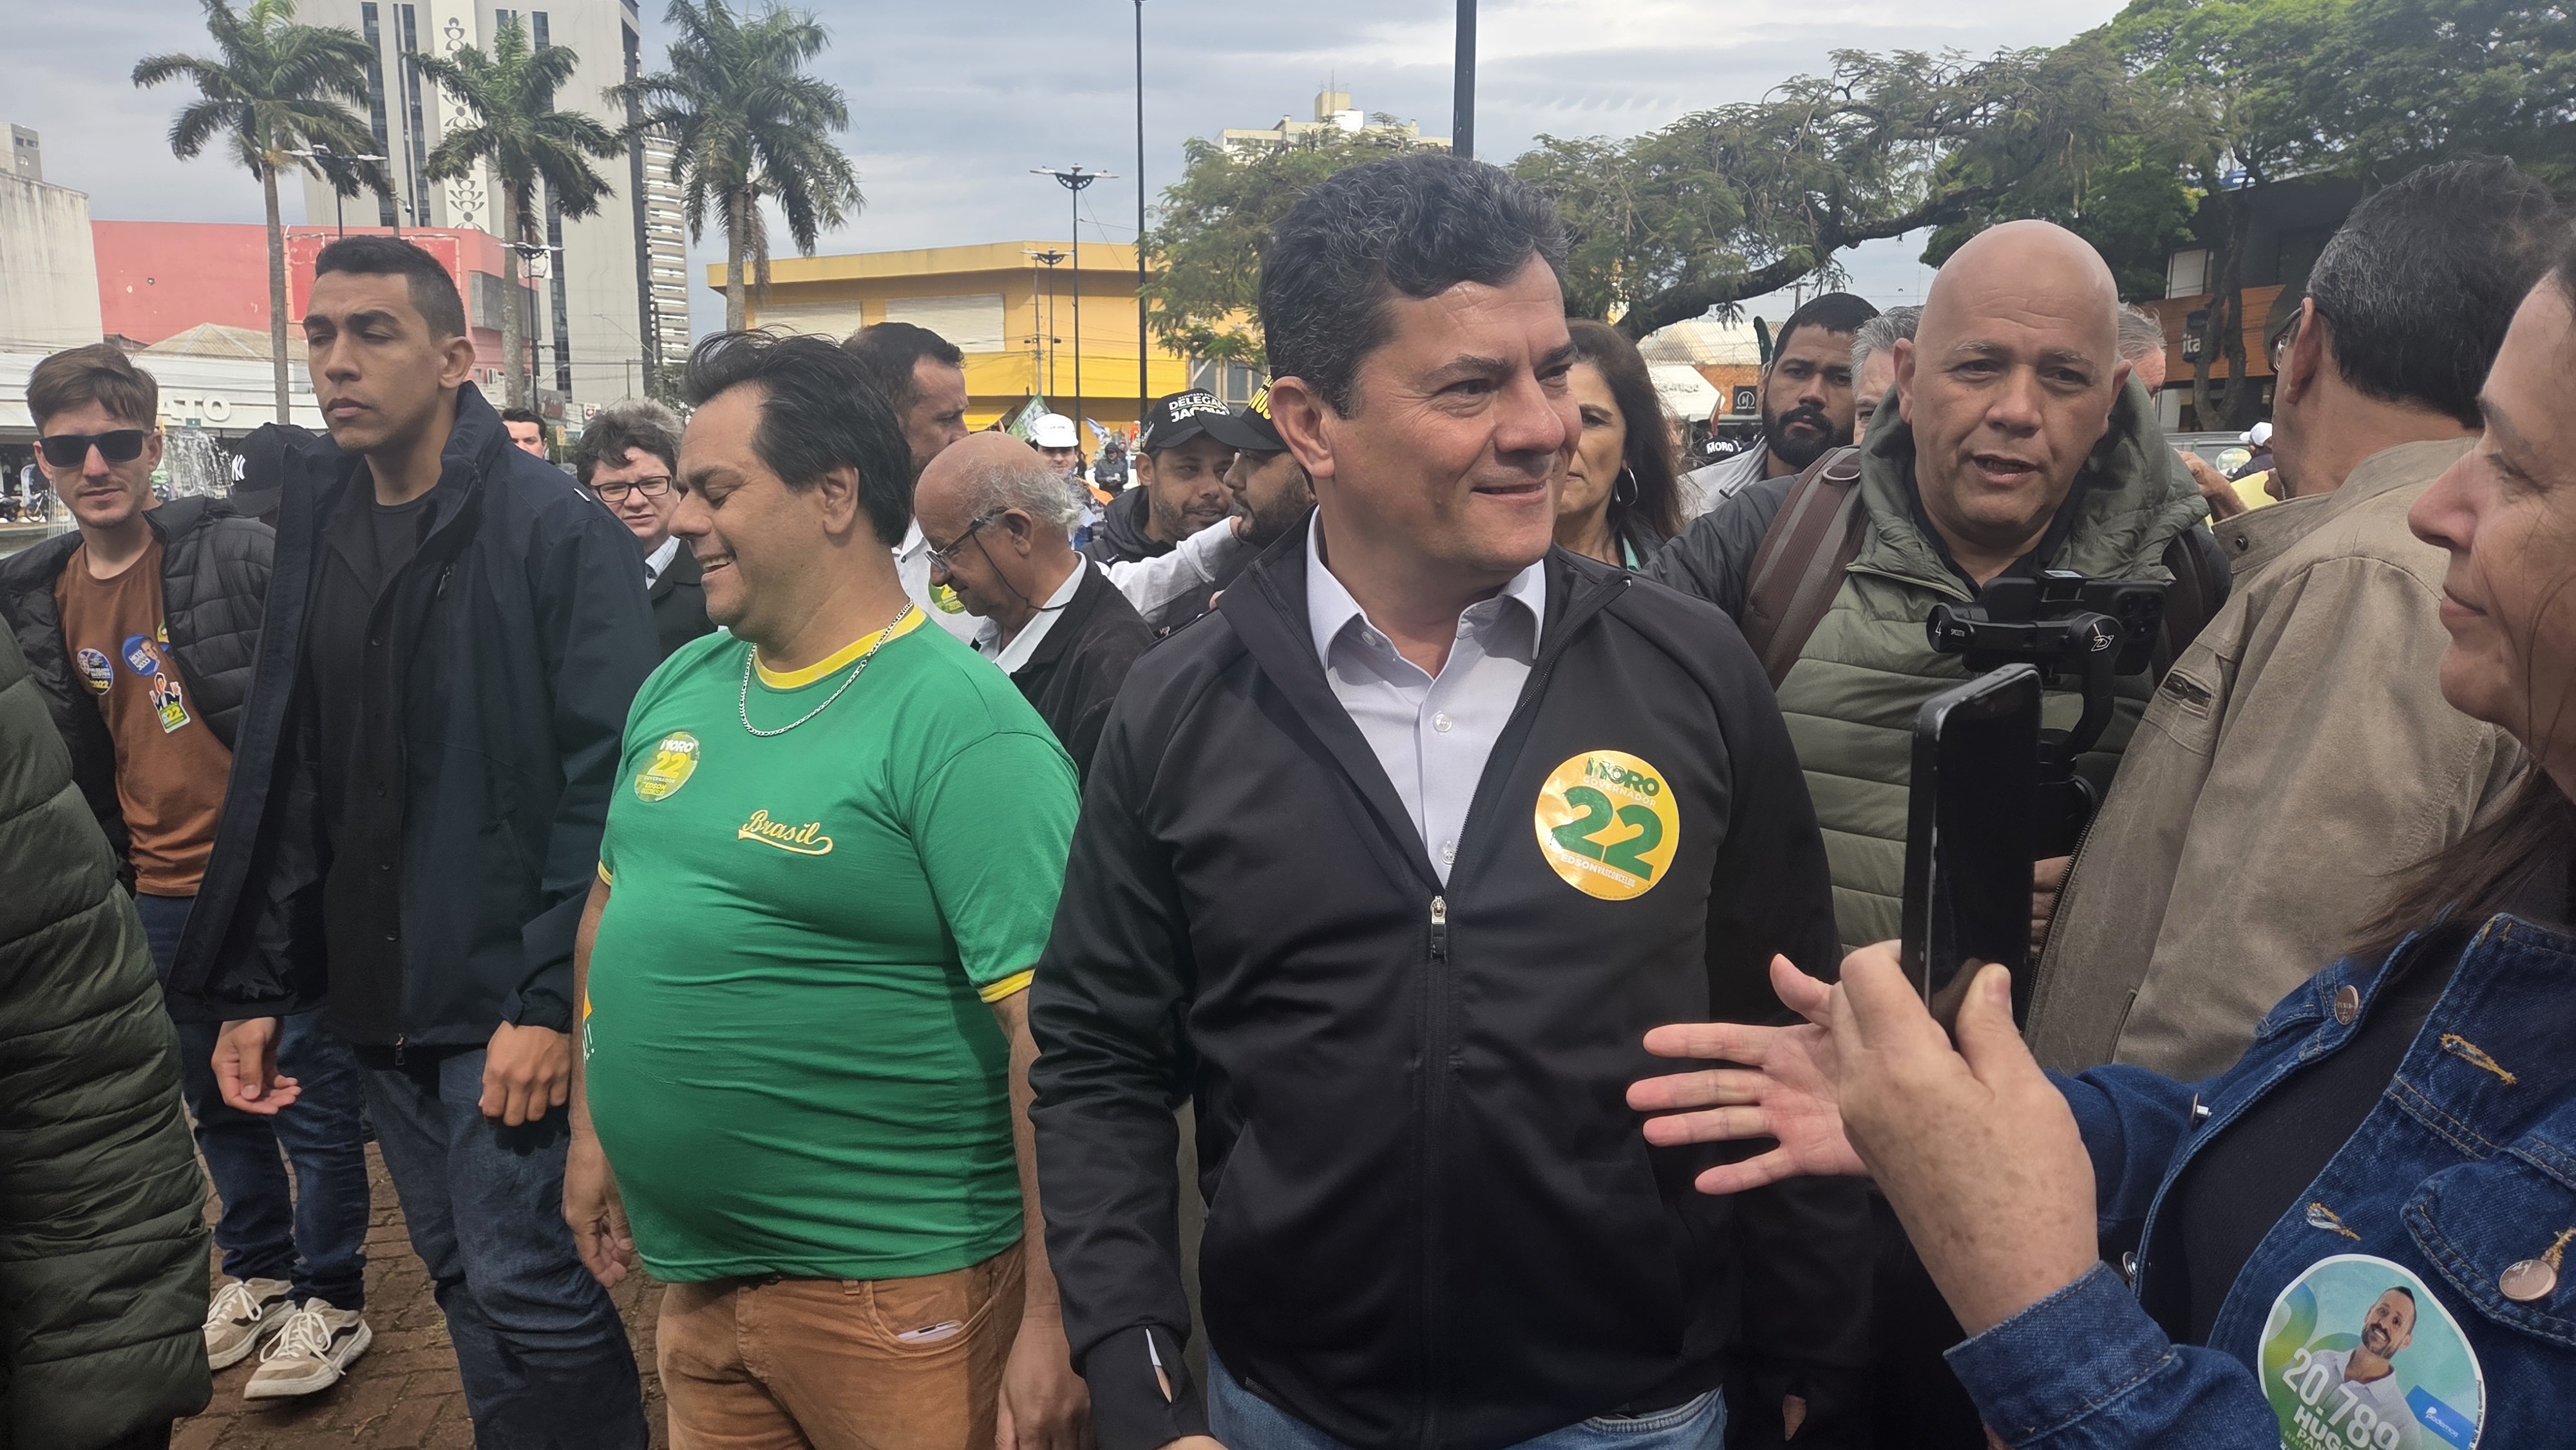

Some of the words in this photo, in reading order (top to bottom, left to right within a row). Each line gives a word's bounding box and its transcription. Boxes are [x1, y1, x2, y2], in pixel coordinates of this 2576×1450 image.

[1169, 396, 1230, 415] DELEGADO
[1707, 441, 1734, 454] MORO
[166, 706, 184, 720] 22
[659, 740, 694, 753] MORO
[647, 751, 687, 778] 22
[1585, 756, 1660, 797] MORO
[1583, 777, 1657, 807] GOVERNADOR
[742, 809, 833, 846] Brasil
[1551, 786, 1663, 881] 22
[2282, 1348, 2400, 1450] 20.789
[2293, 1404, 2352, 1450] HUG
[2425, 1413, 2459, 1437] podemos
